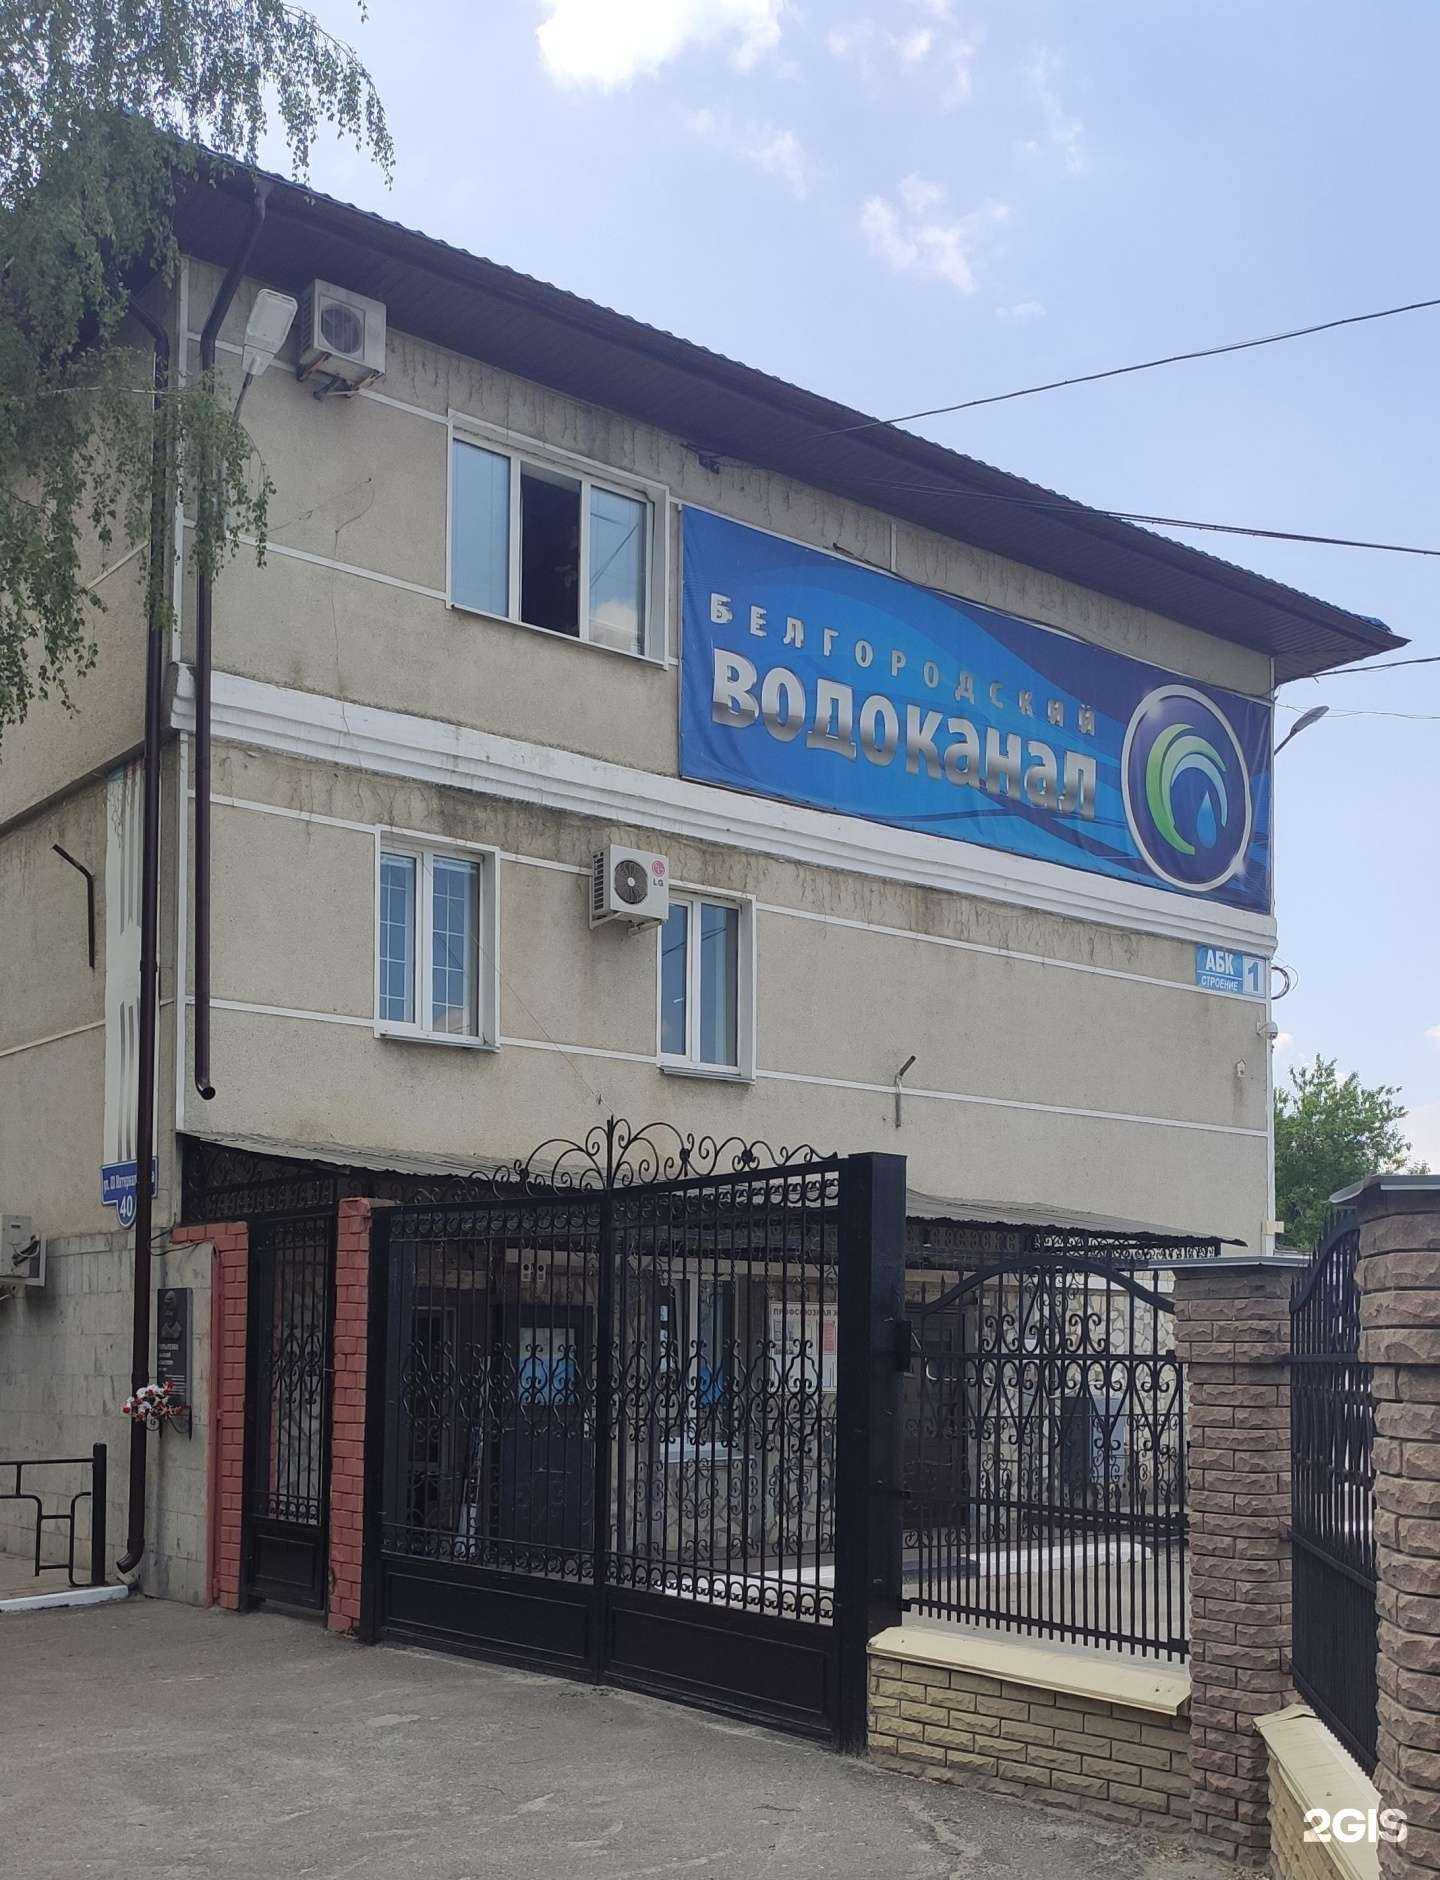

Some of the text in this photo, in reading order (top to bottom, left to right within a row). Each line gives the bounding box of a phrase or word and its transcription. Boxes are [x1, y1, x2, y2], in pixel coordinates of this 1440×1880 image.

[710, 592, 1095, 736] БЕЛГОРОДСКИЙ
[653, 878, 664, 887] LG
[1205, 949, 1234, 975] АБК
[1201, 975, 1238, 991] СТРОЕНИЕ
[1247, 961, 1259, 992] 1
[120, 1195, 133, 1217] 40
